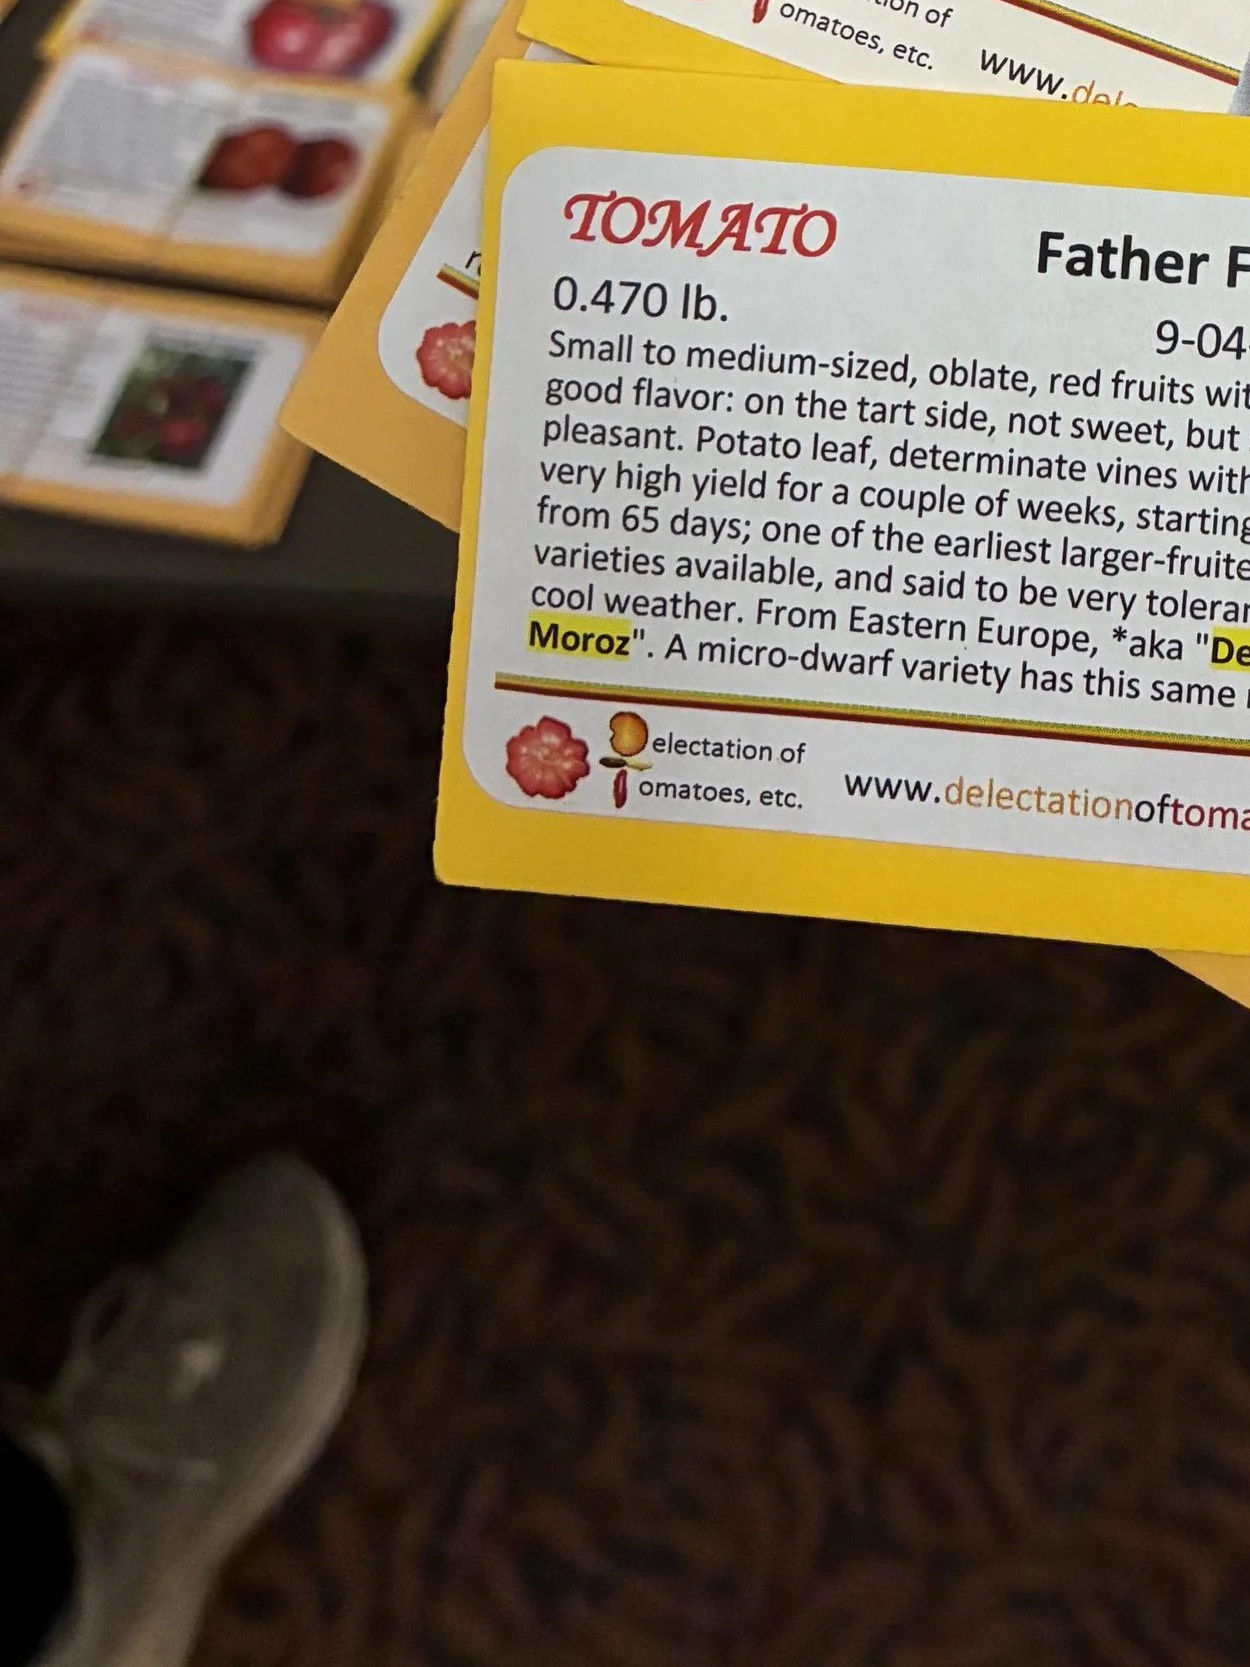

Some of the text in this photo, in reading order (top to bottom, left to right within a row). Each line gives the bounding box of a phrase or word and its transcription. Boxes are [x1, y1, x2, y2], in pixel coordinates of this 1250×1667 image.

[924, 7, 954, 28] of
[892, 43, 933, 71] etc.
[563, 190, 838, 258] TOMATO
[1037, 230, 1210, 286] Father
[553, 275, 728, 322] 0.470 lb.
[548, 329, 634, 364] Small
[642, 339, 676, 366] to
[686, 342, 918, 389] medium-sized,
[928, 357, 1037, 398] oblate,
[1049, 368, 1102, 398] red
[1110, 369, 1195, 405] fruits
[545, 375, 623, 407] good
[632, 376, 734, 413] flavor:
[744, 392, 784, 416] on
[794, 389, 848, 421] the
[856, 396, 916, 426] tart
[924, 400, 996, 438] side,
[1008, 410, 1062, 438] not
[1070, 417, 1174, 452] sweet,
[1186, 418, 1241, 452] but
[543, 413, 684, 452] pleasant.
[696, 425, 802, 460] Potato
[811, 431, 878, 471] leaf,
[889, 438, 1087, 482] determinate
[1096, 456, 1178, 490] vines
[536, 494, 610, 530] from
[621, 504, 660, 534] 65
[669, 506, 751, 546] days;
[761, 520, 821, 546] one
[830, 519, 866, 549] of
[871, 522, 925, 554] the
[933, 530, 1052, 565] earliest
[540, 461, 607, 494] very
[615, 459, 682, 499] high
[692, 467, 767, 502] yield
[776, 471, 824, 503] for
[831, 483, 849, 506] a
[859, 483, 966, 519] couple
[974, 488, 1010, 518] of
[1016, 495, 1125, 533] weeks,
[534, 541, 666, 576] varieties
[675, 553, 823, 593] available,
[834, 564, 893, 594] and
[902, 569, 966, 600] said
[974, 575, 1008, 603] to
[1019, 575, 1058, 608] be
[1067, 587, 1138, 621] very
[531, 583, 594, 612] cool
[603, 590, 744, 624] weather.
[756, 597, 837, 631] From
[849, 605, 966, 642] Eastern
[977, 615, 1098, 659] Europe,
[664, 633, 688, 661] A
[697, 636, 895, 677] micro-dwarf
[901, 655, 1012, 695] variety
[1020, 660, 1074, 694] has
[1082, 666, 1141, 700] this
[1150, 679, 1236, 708] same
[779, 742, 807, 764] of
[759, 789, 803, 810] etc.
